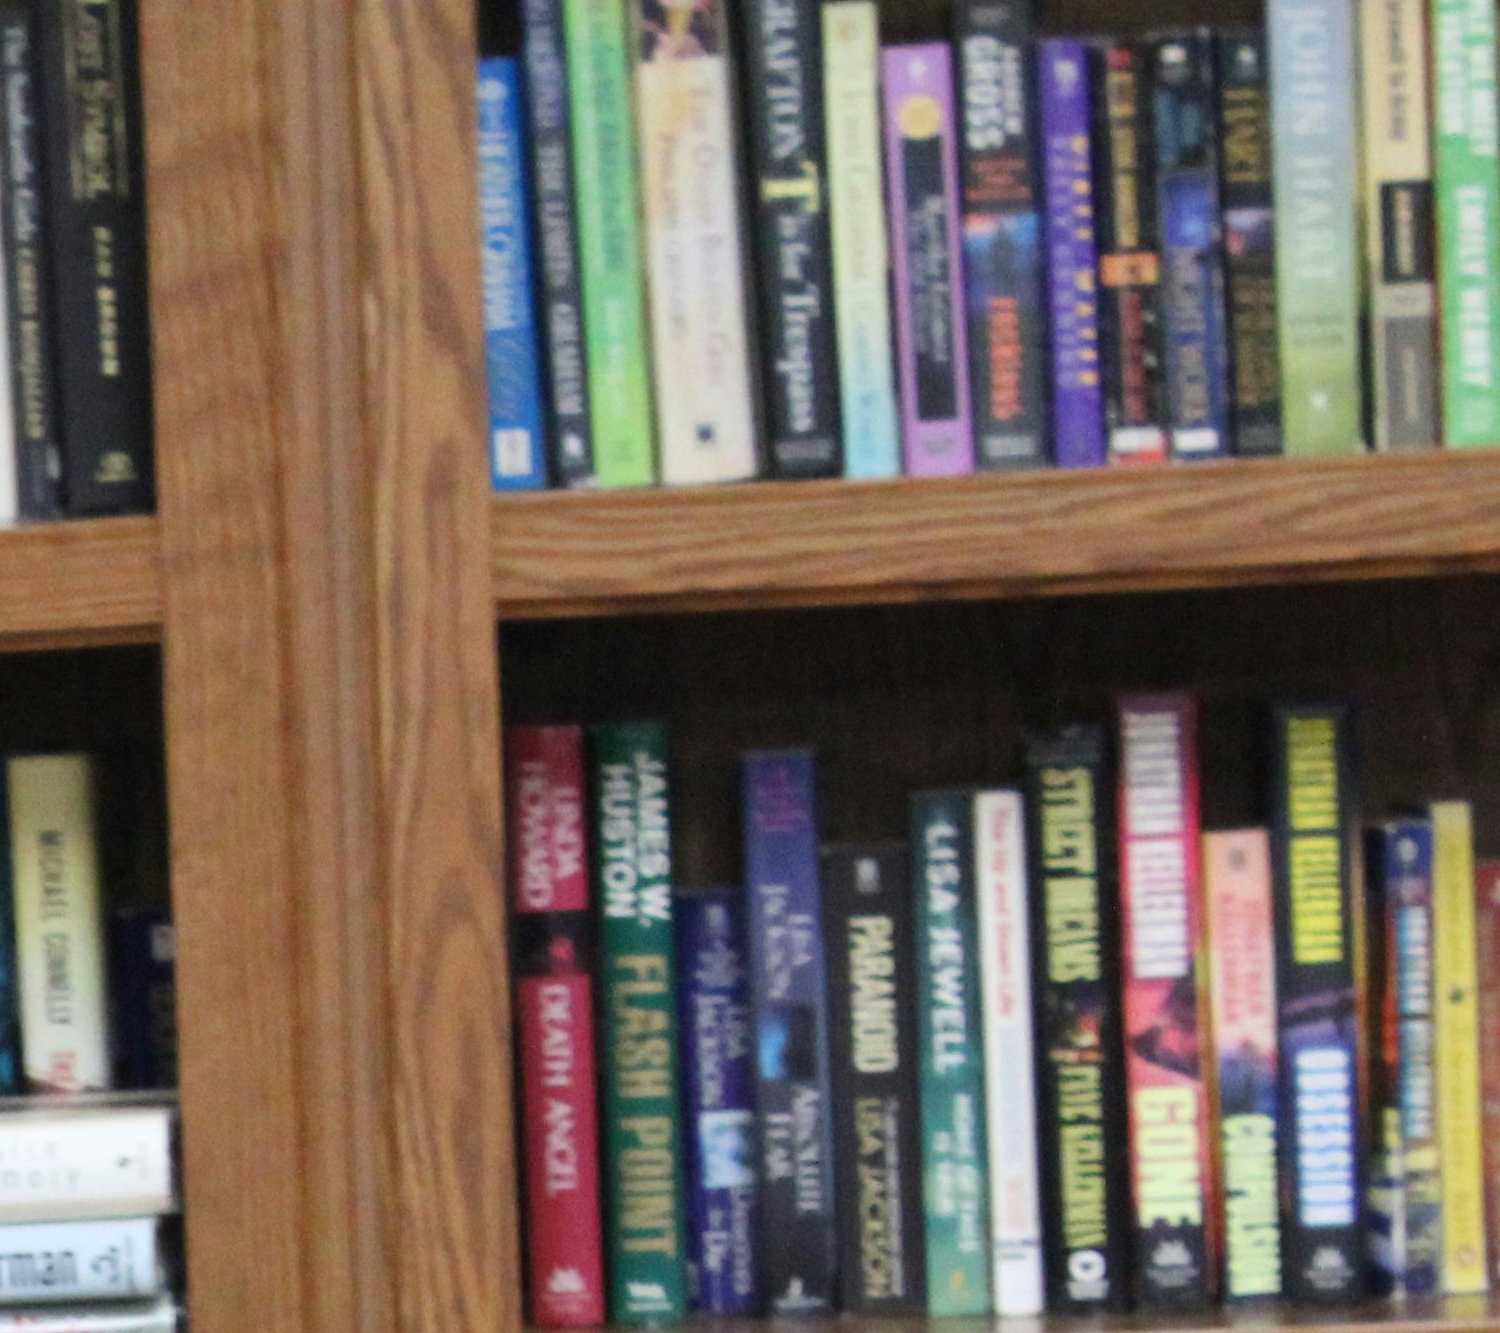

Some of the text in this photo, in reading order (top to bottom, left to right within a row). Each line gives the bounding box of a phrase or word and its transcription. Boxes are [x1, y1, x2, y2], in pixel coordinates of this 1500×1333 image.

[966, 36, 1005, 152] GROSS
[1280, 6, 1338, 281] JOHN HART
[760, 160, 820, 213] T
[775, 284, 819, 432] Trespass
[1457, 184, 1492, 387] EMILY HENRY
[517, 763, 551, 908] HOWARD
[553, 788, 579, 879] LINDA
[601, 763, 636, 918] HUSTON
[632, 751, 670, 927] JAMES W.
[1041, 767, 1100, 983] STREET DREAMS
[38, 830, 75, 1027] MICHAEL CONNELLY
[760, 886, 792, 1001] JACKSON
[786, 914, 813, 967] LISA
[848, 915, 899, 1075] PARANOID
[925, 822, 967, 1075] LISA JEWELL
[540, 983, 576, 1198] DEATH ANGEL
[613, 953, 677, 1258] FLASH POINT
[693, 995, 724, 1108] JACKSON
[764, 1113, 798, 1182] FEAR
[790, 1086, 822, 1215] ABSOLUTE
[854, 1097, 893, 1299] LISA JACKSON
[1057, 1065, 1108, 1248] FAYE KELLERMAN
[1133, 1084, 1203, 1229] GONE
[1221, 1113, 1283, 1297] COMPULSION
[1294, 1047, 1355, 1229] OBSESSION
